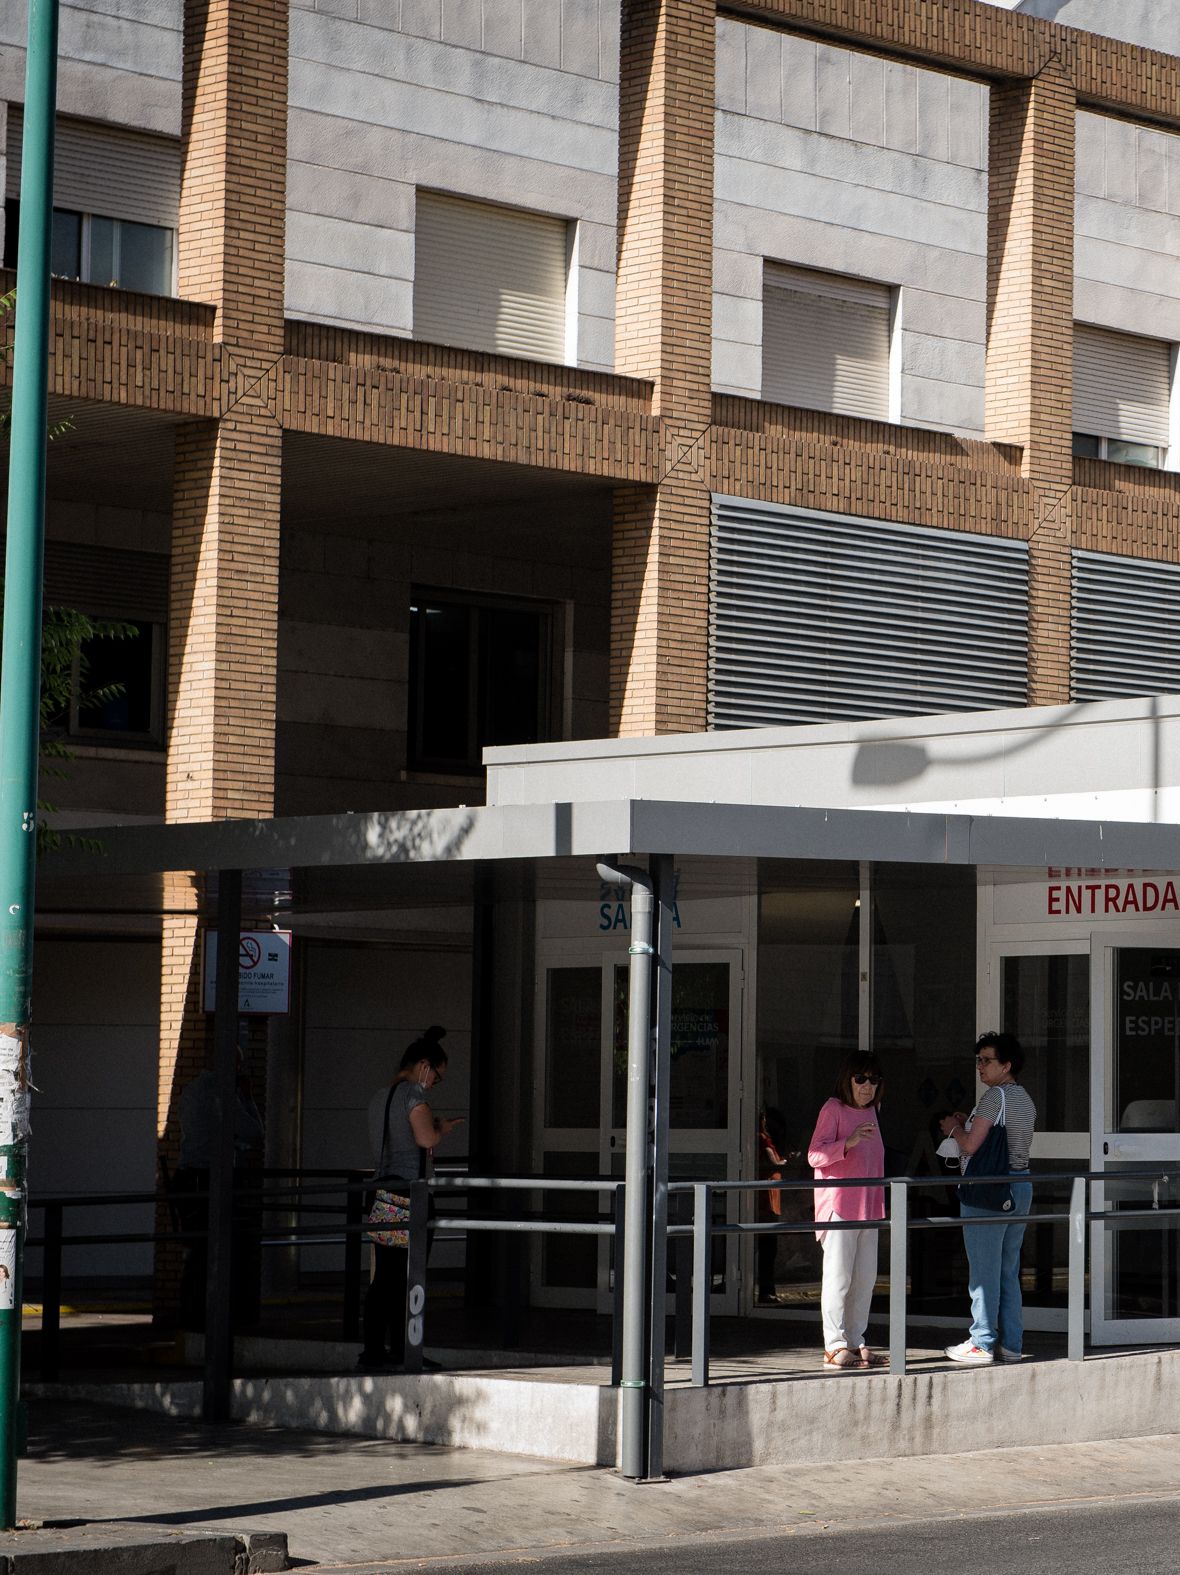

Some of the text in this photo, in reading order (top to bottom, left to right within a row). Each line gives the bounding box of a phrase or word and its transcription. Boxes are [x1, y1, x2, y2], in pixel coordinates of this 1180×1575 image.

[1047, 881, 1180, 915] ENTRADA
[599, 901, 682, 930] SAA
[253, 972, 274, 980] FUMAR
[1122, 981, 1173, 1001] SALA
[671, 1022, 719, 1032] RGENCIAS
